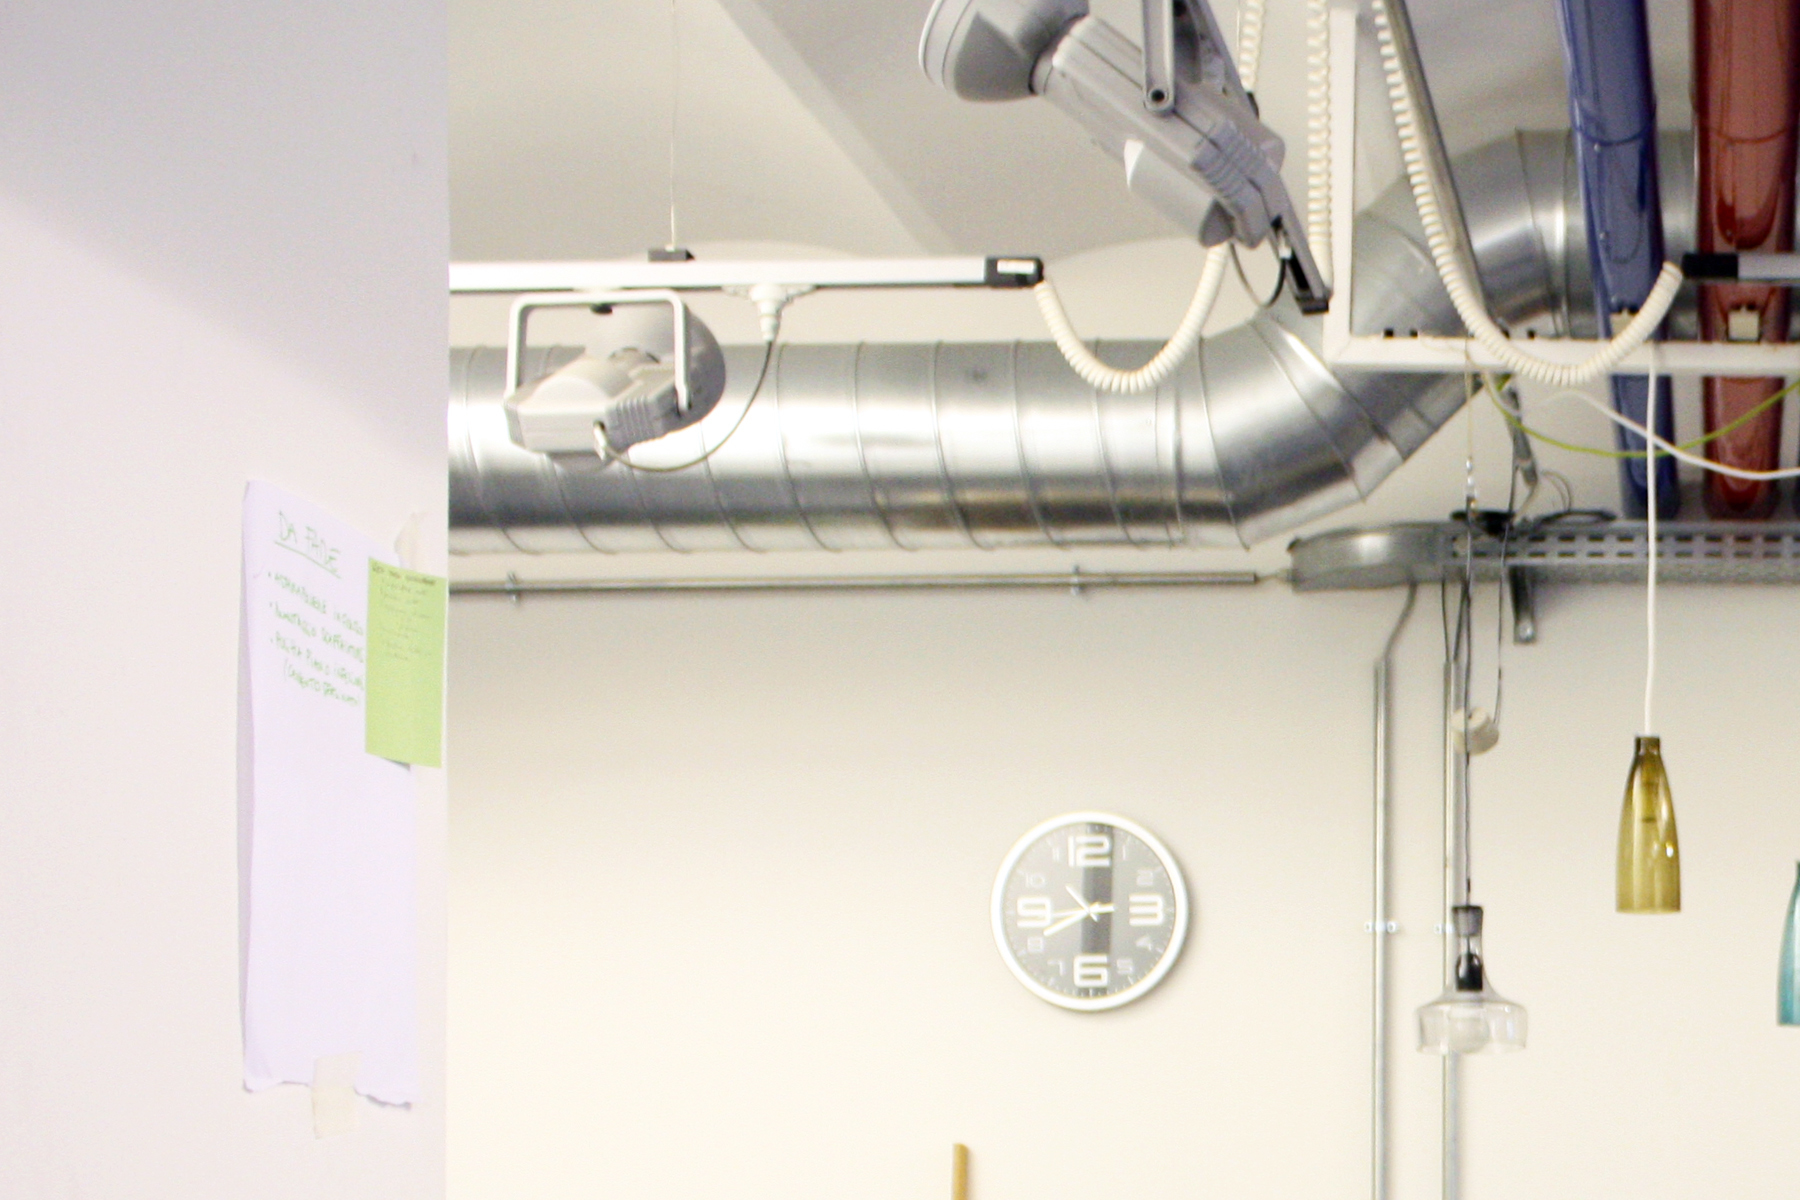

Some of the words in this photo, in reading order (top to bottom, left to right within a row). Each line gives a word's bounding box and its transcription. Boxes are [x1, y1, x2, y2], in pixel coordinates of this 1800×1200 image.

[1068, 834, 1111, 867] 12
[1136, 871, 1154, 886] 2
[1017, 895, 1051, 928] 9
[1129, 894, 1164, 926] 3
[1074, 955, 1108, 988] 6
[1117, 959, 1135, 974] 5
